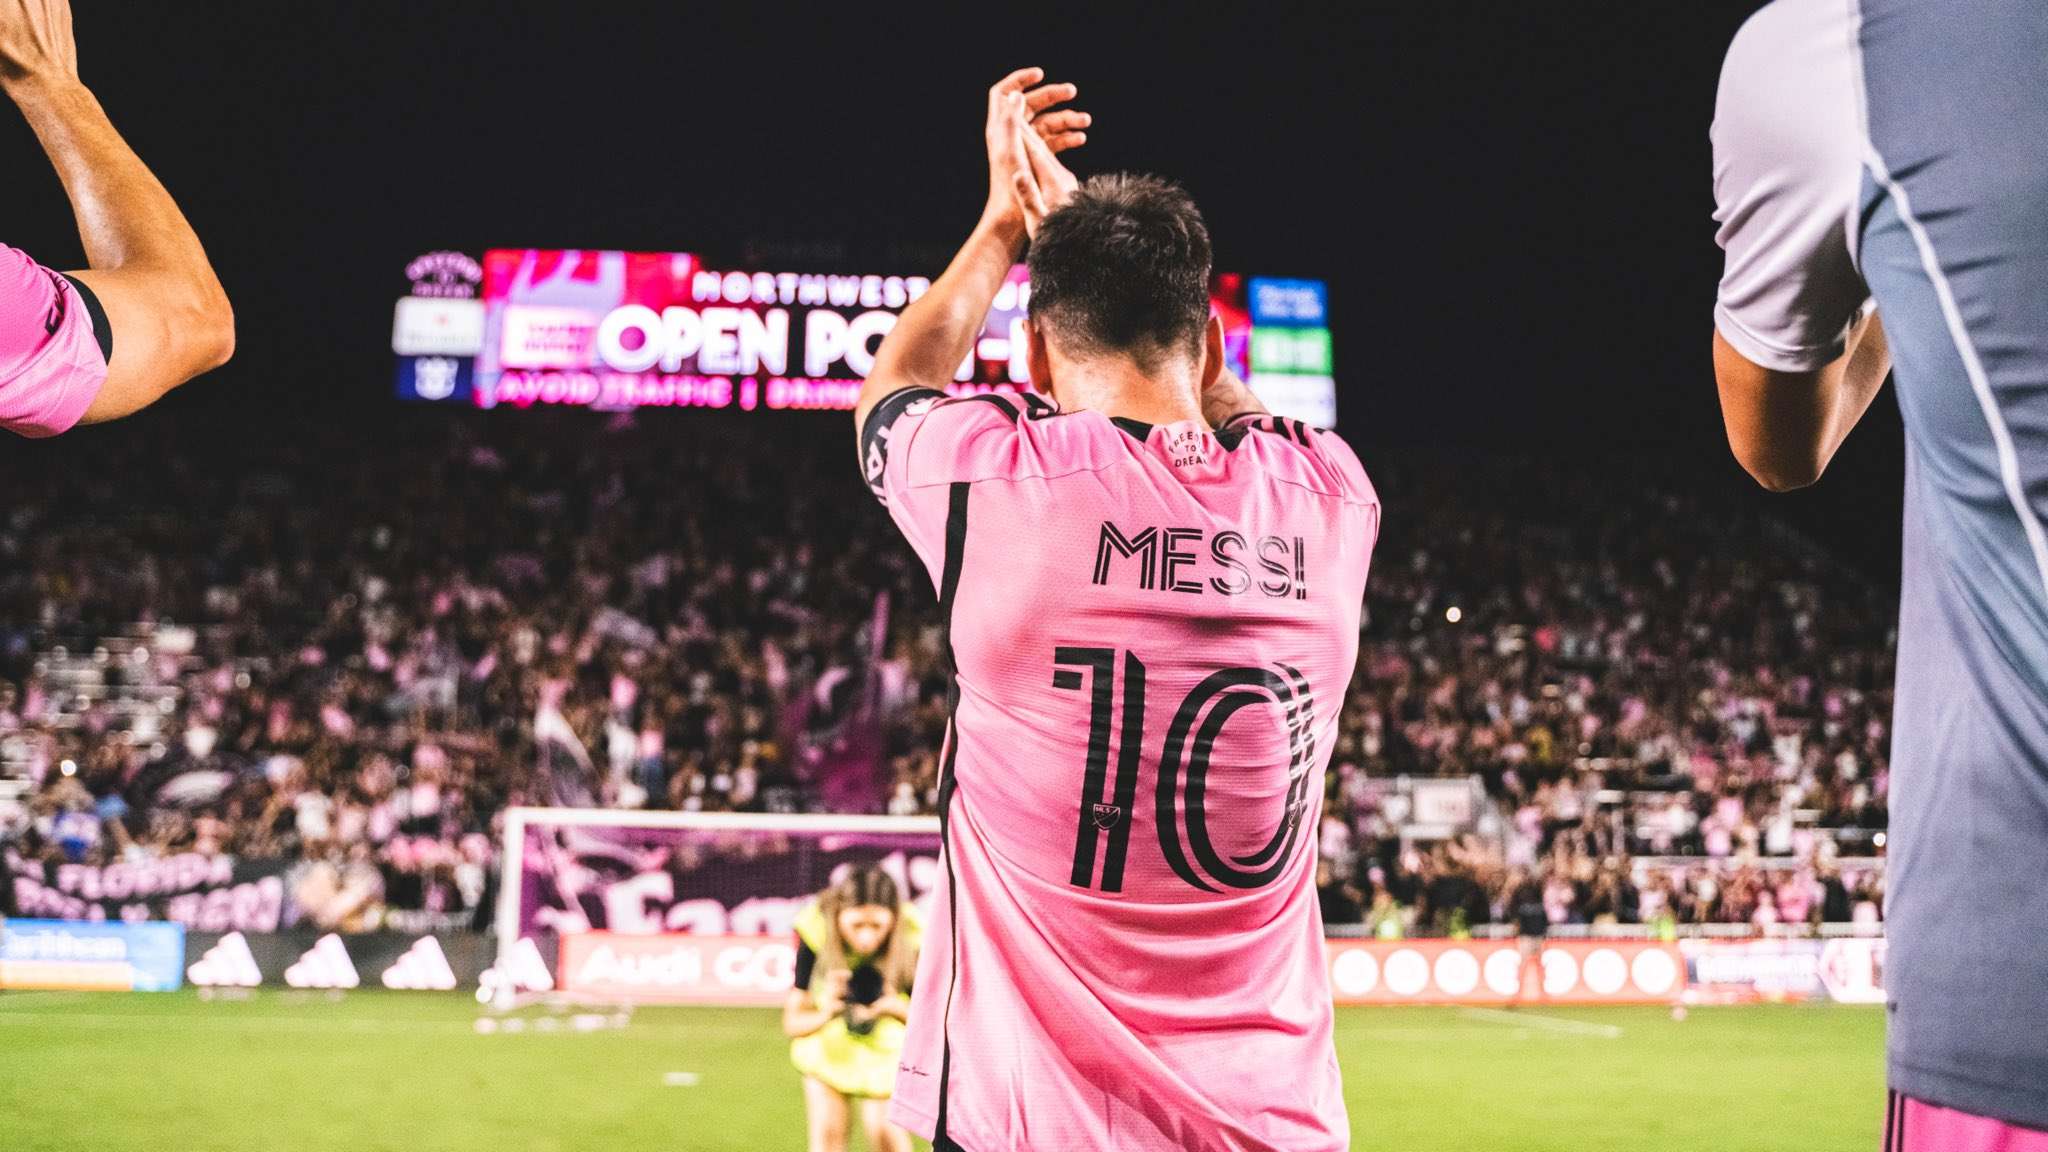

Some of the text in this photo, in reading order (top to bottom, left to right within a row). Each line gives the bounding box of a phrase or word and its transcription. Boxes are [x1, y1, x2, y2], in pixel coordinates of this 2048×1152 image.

[692, 271, 931, 308] NORTHWEST
[597, 304, 789, 377] OPEN
[1174, 455, 1208, 468] DREA
[1092, 520, 1307, 601] MESSI
[1052, 646, 1316, 895] 10
[580, 944, 701, 987] Audi
